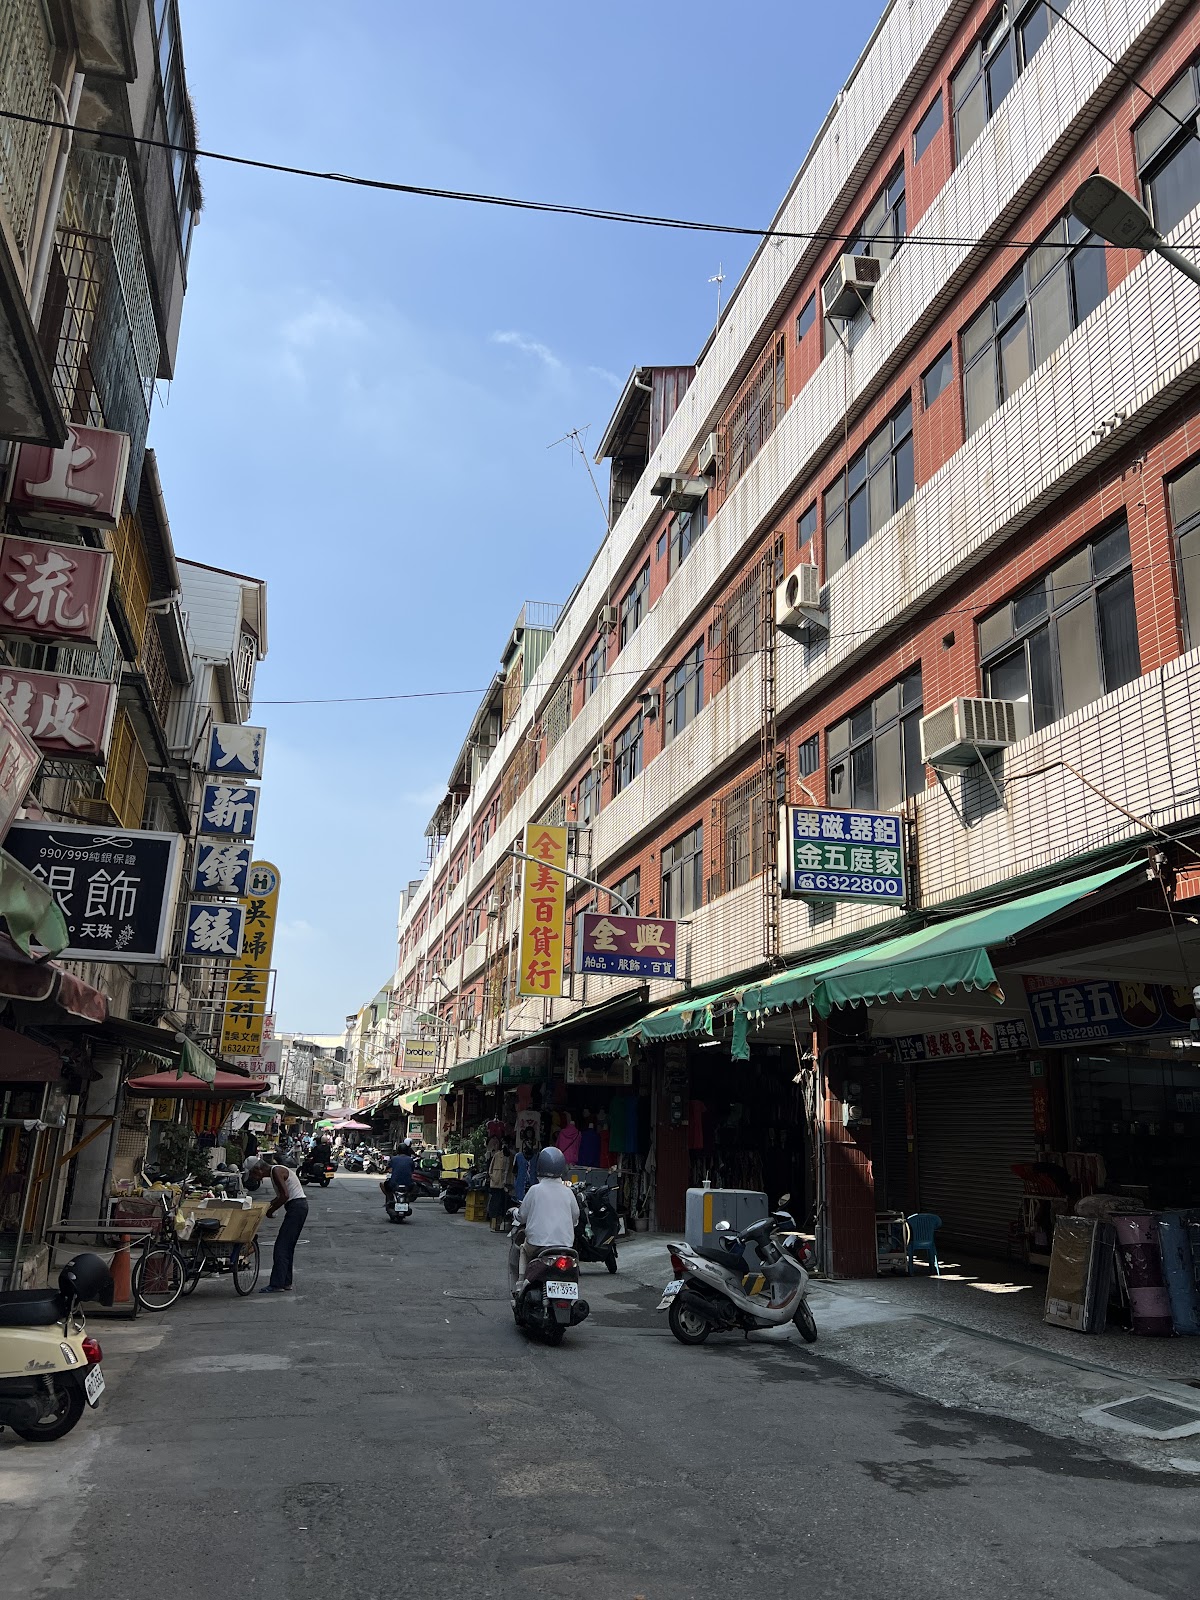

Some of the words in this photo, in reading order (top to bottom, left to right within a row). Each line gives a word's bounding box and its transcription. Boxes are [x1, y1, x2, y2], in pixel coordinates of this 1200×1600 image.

[39, 848, 137, 866] 990/999純銀保證
[816, 874, 898, 894] 6322800
[526, 831, 562, 990] 全美百貨行
[1060, 1025, 1109, 1040] 6322800
[406, 1048, 433, 1056] brother
